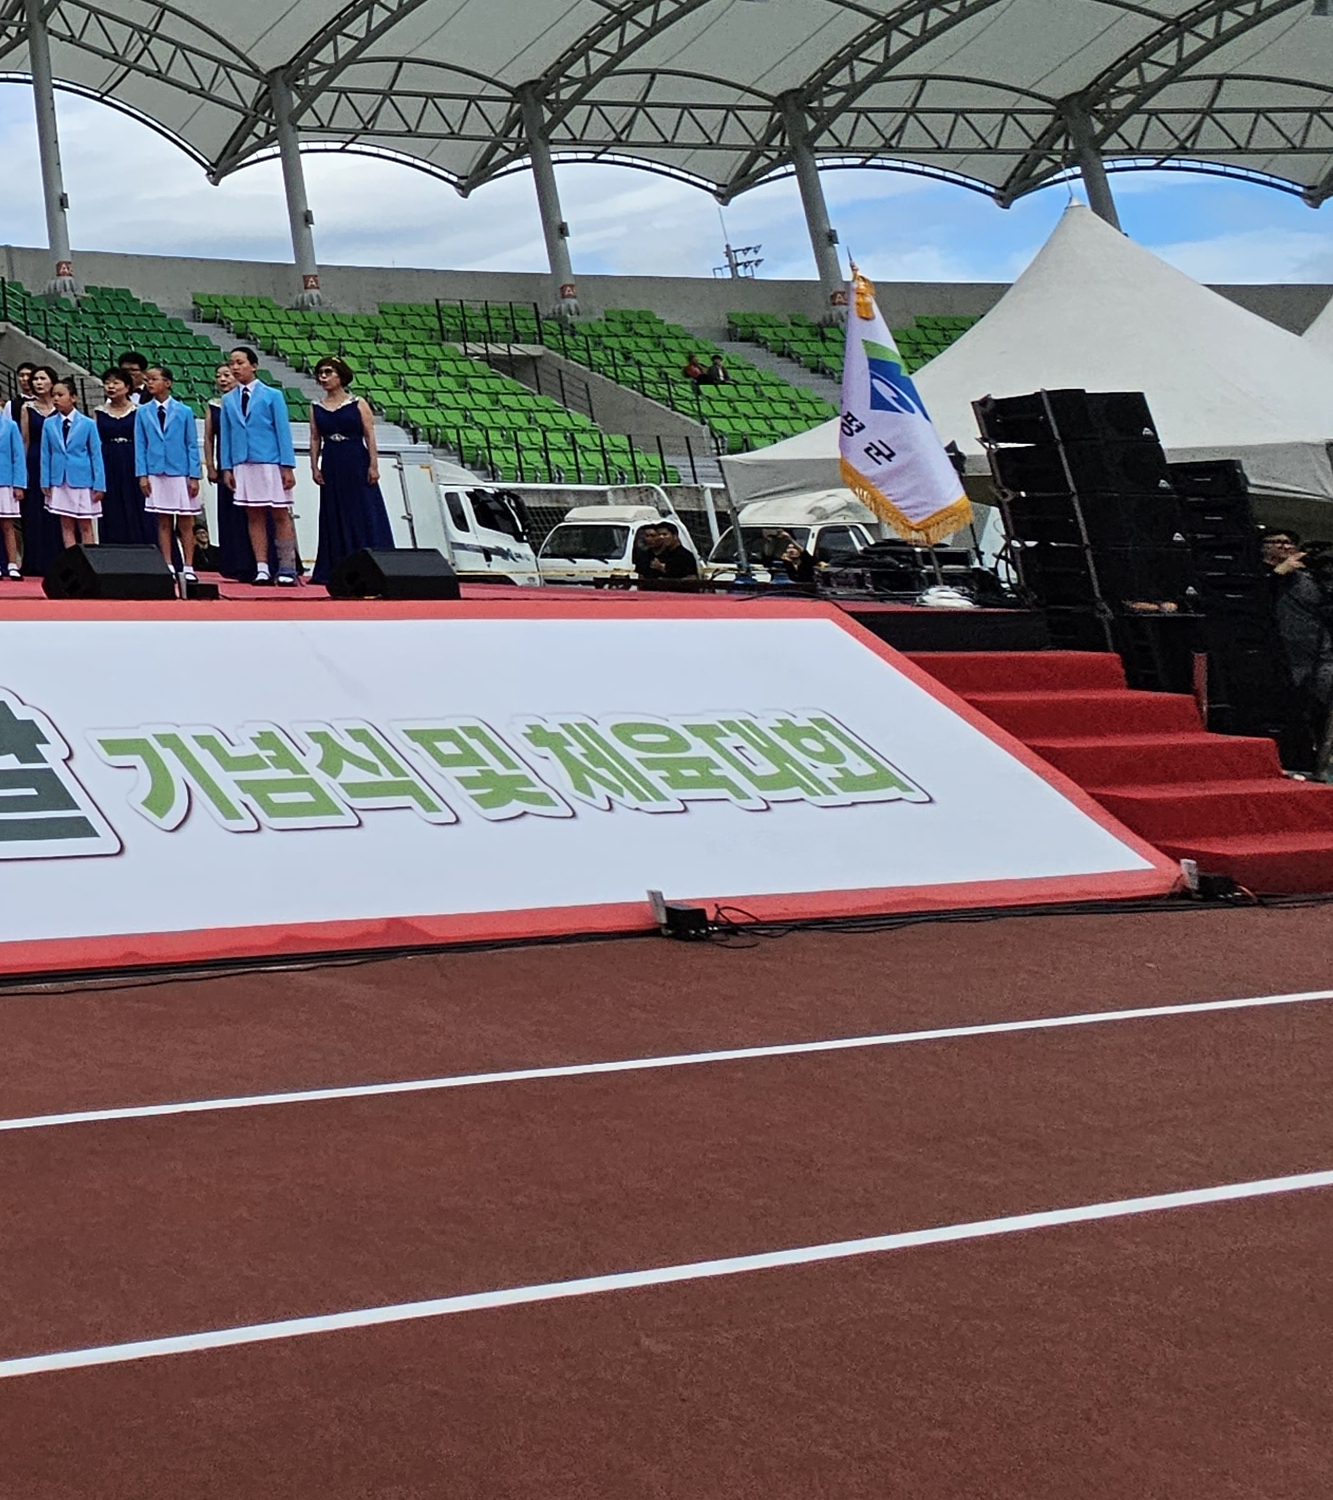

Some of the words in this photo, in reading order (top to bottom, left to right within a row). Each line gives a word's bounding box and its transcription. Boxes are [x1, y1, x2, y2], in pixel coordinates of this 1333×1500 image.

[97, 729, 440, 821] 기념식
[405, 726, 555, 810] 및
[524, 718, 910, 802] 체육대회
